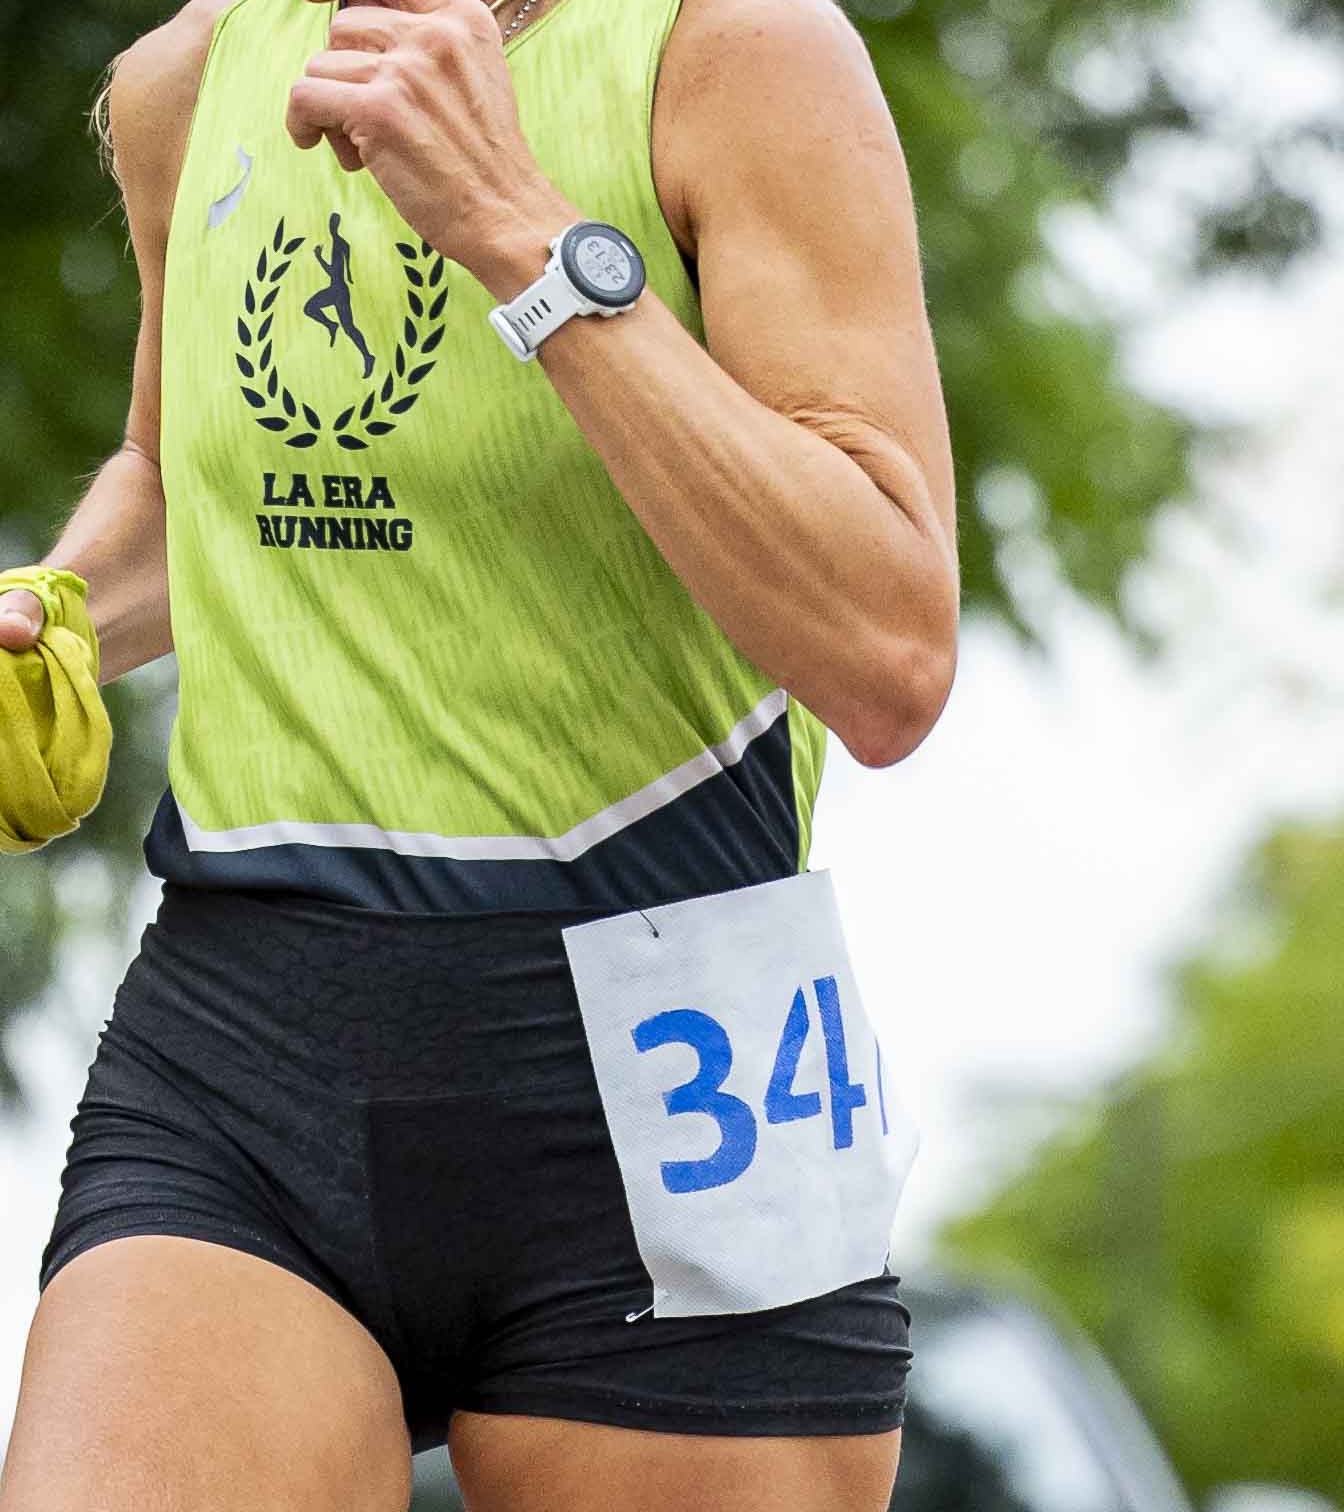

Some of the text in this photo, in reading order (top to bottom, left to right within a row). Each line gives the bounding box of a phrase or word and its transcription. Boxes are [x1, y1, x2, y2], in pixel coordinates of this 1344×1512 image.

[263, 473, 396, 509] LA ERA
[256, 515, 413, 551] RUNNING
[630, 975, 889, 1194] 34
